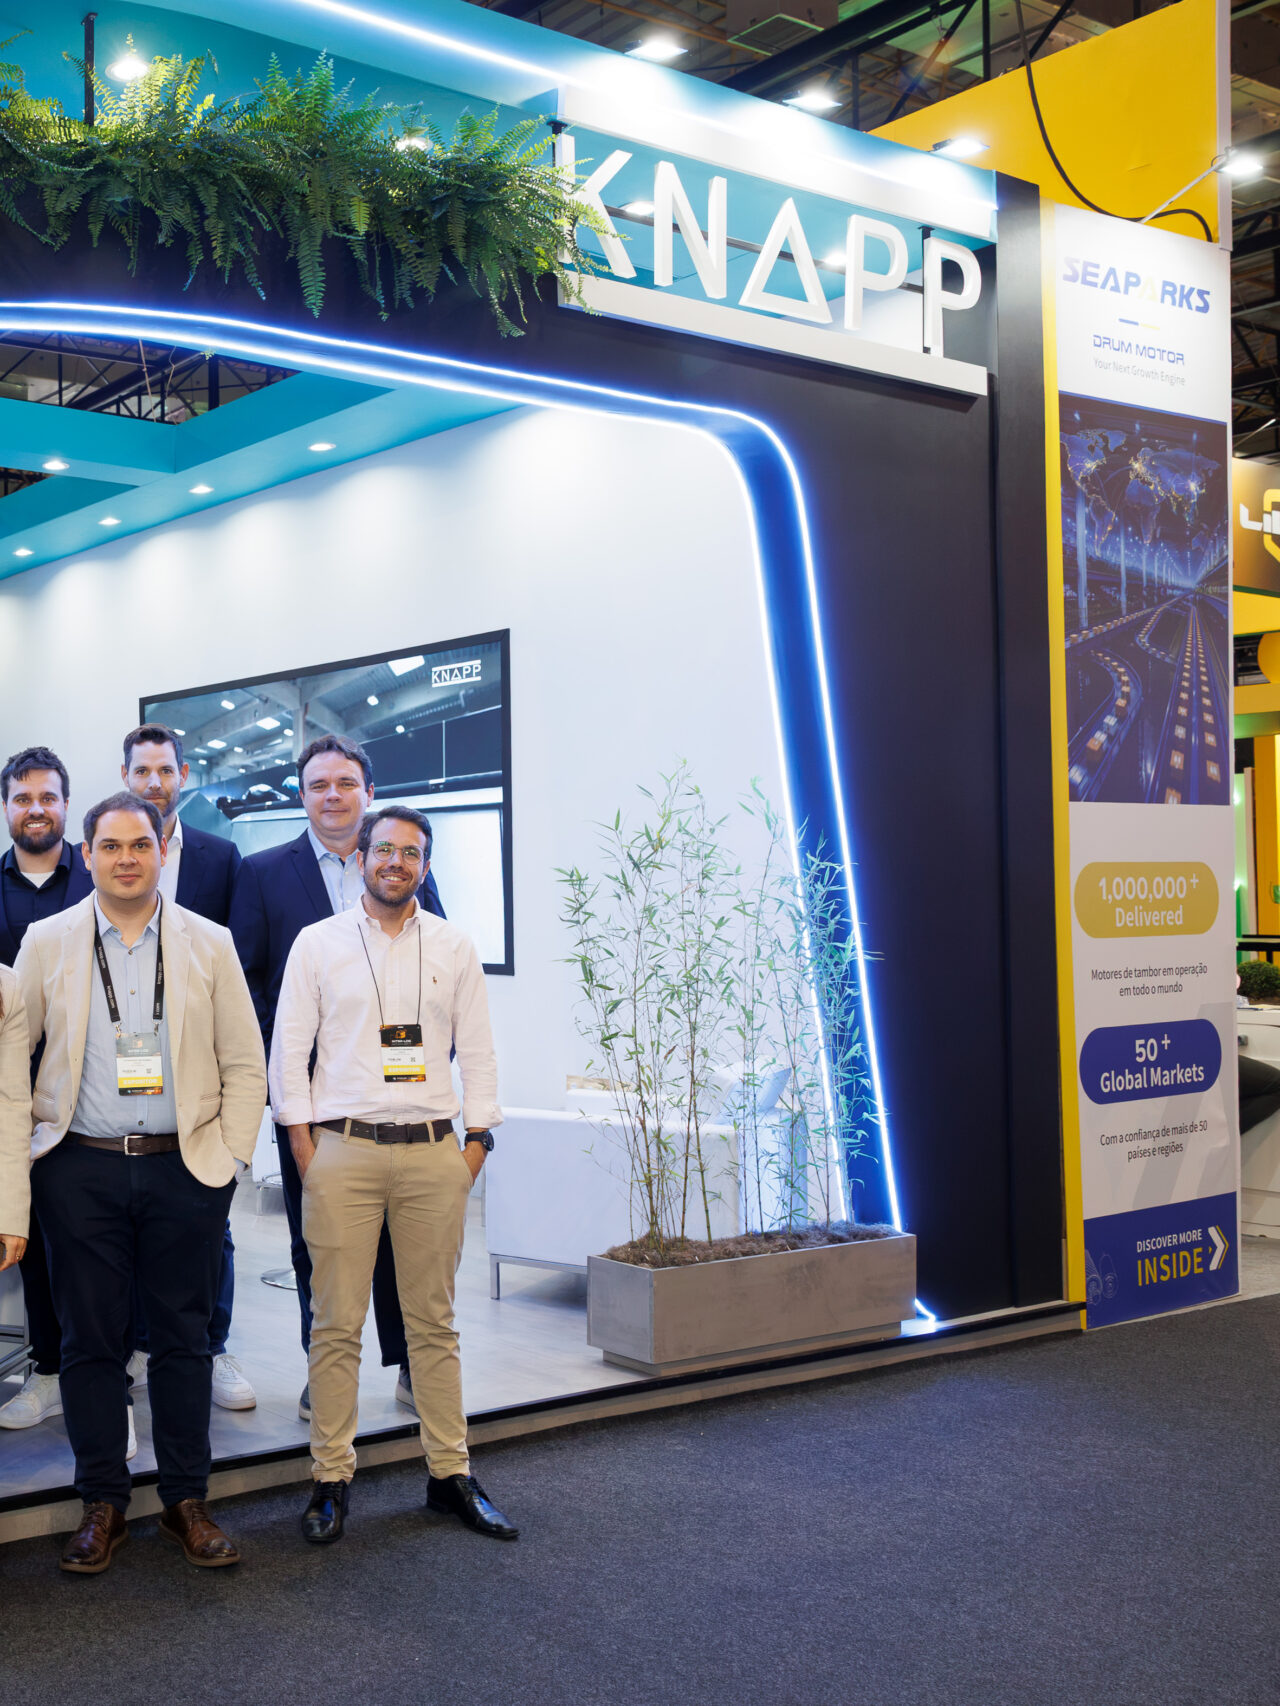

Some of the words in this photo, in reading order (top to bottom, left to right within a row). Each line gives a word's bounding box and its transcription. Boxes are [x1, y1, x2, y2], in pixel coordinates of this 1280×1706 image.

[558, 134, 982, 358] KNAPP
[1062, 256, 1211, 314] SEAPARKS
[1093, 334, 1133, 355] DRUM
[1135, 343, 1185, 366] MOTOR
[1113, 361, 1130, 375] Next
[432, 664, 481, 684] KNAPP
[1115, 905, 1183, 927] Delivered
[1091, 969, 1122, 981] Motores
[1123, 967, 1133, 979] de
[1134, 965, 1161, 978] tambor
[1163, 967, 1173, 977] em
[1175, 962, 1208, 978] operação
[1120, 987, 1131, 997] em
[1133, 984, 1150, 996] todo
[1151, 986, 1156, 995] o
[1158, 981, 1183, 994] mundo
[1100, 1068, 1147, 1093] Global
[1150, 1064, 1205, 1087] Markets
[1100, 1134, 1118, 1146] Com
[1119, 1134, 1124, 1143] a
[1125, 1128, 1160, 1142] confiança
[1161, 1125, 1171, 1137] de
[1172, 1123, 1188, 1136] mais
[1189, 1121, 1198, 1133] de
[1199, 1119, 1208, 1132] 50
[1127, 1145, 1151, 1163] países
[1152, 1147, 1157, 1156] e
[1157, 1141, 1183, 1157] regiões
[1137, 1233, 1178, 1253] DISCOVER
[1179, 1229, 1202, 1244] MORE
[1137, 1248, 1204, 1287] INSIDE
